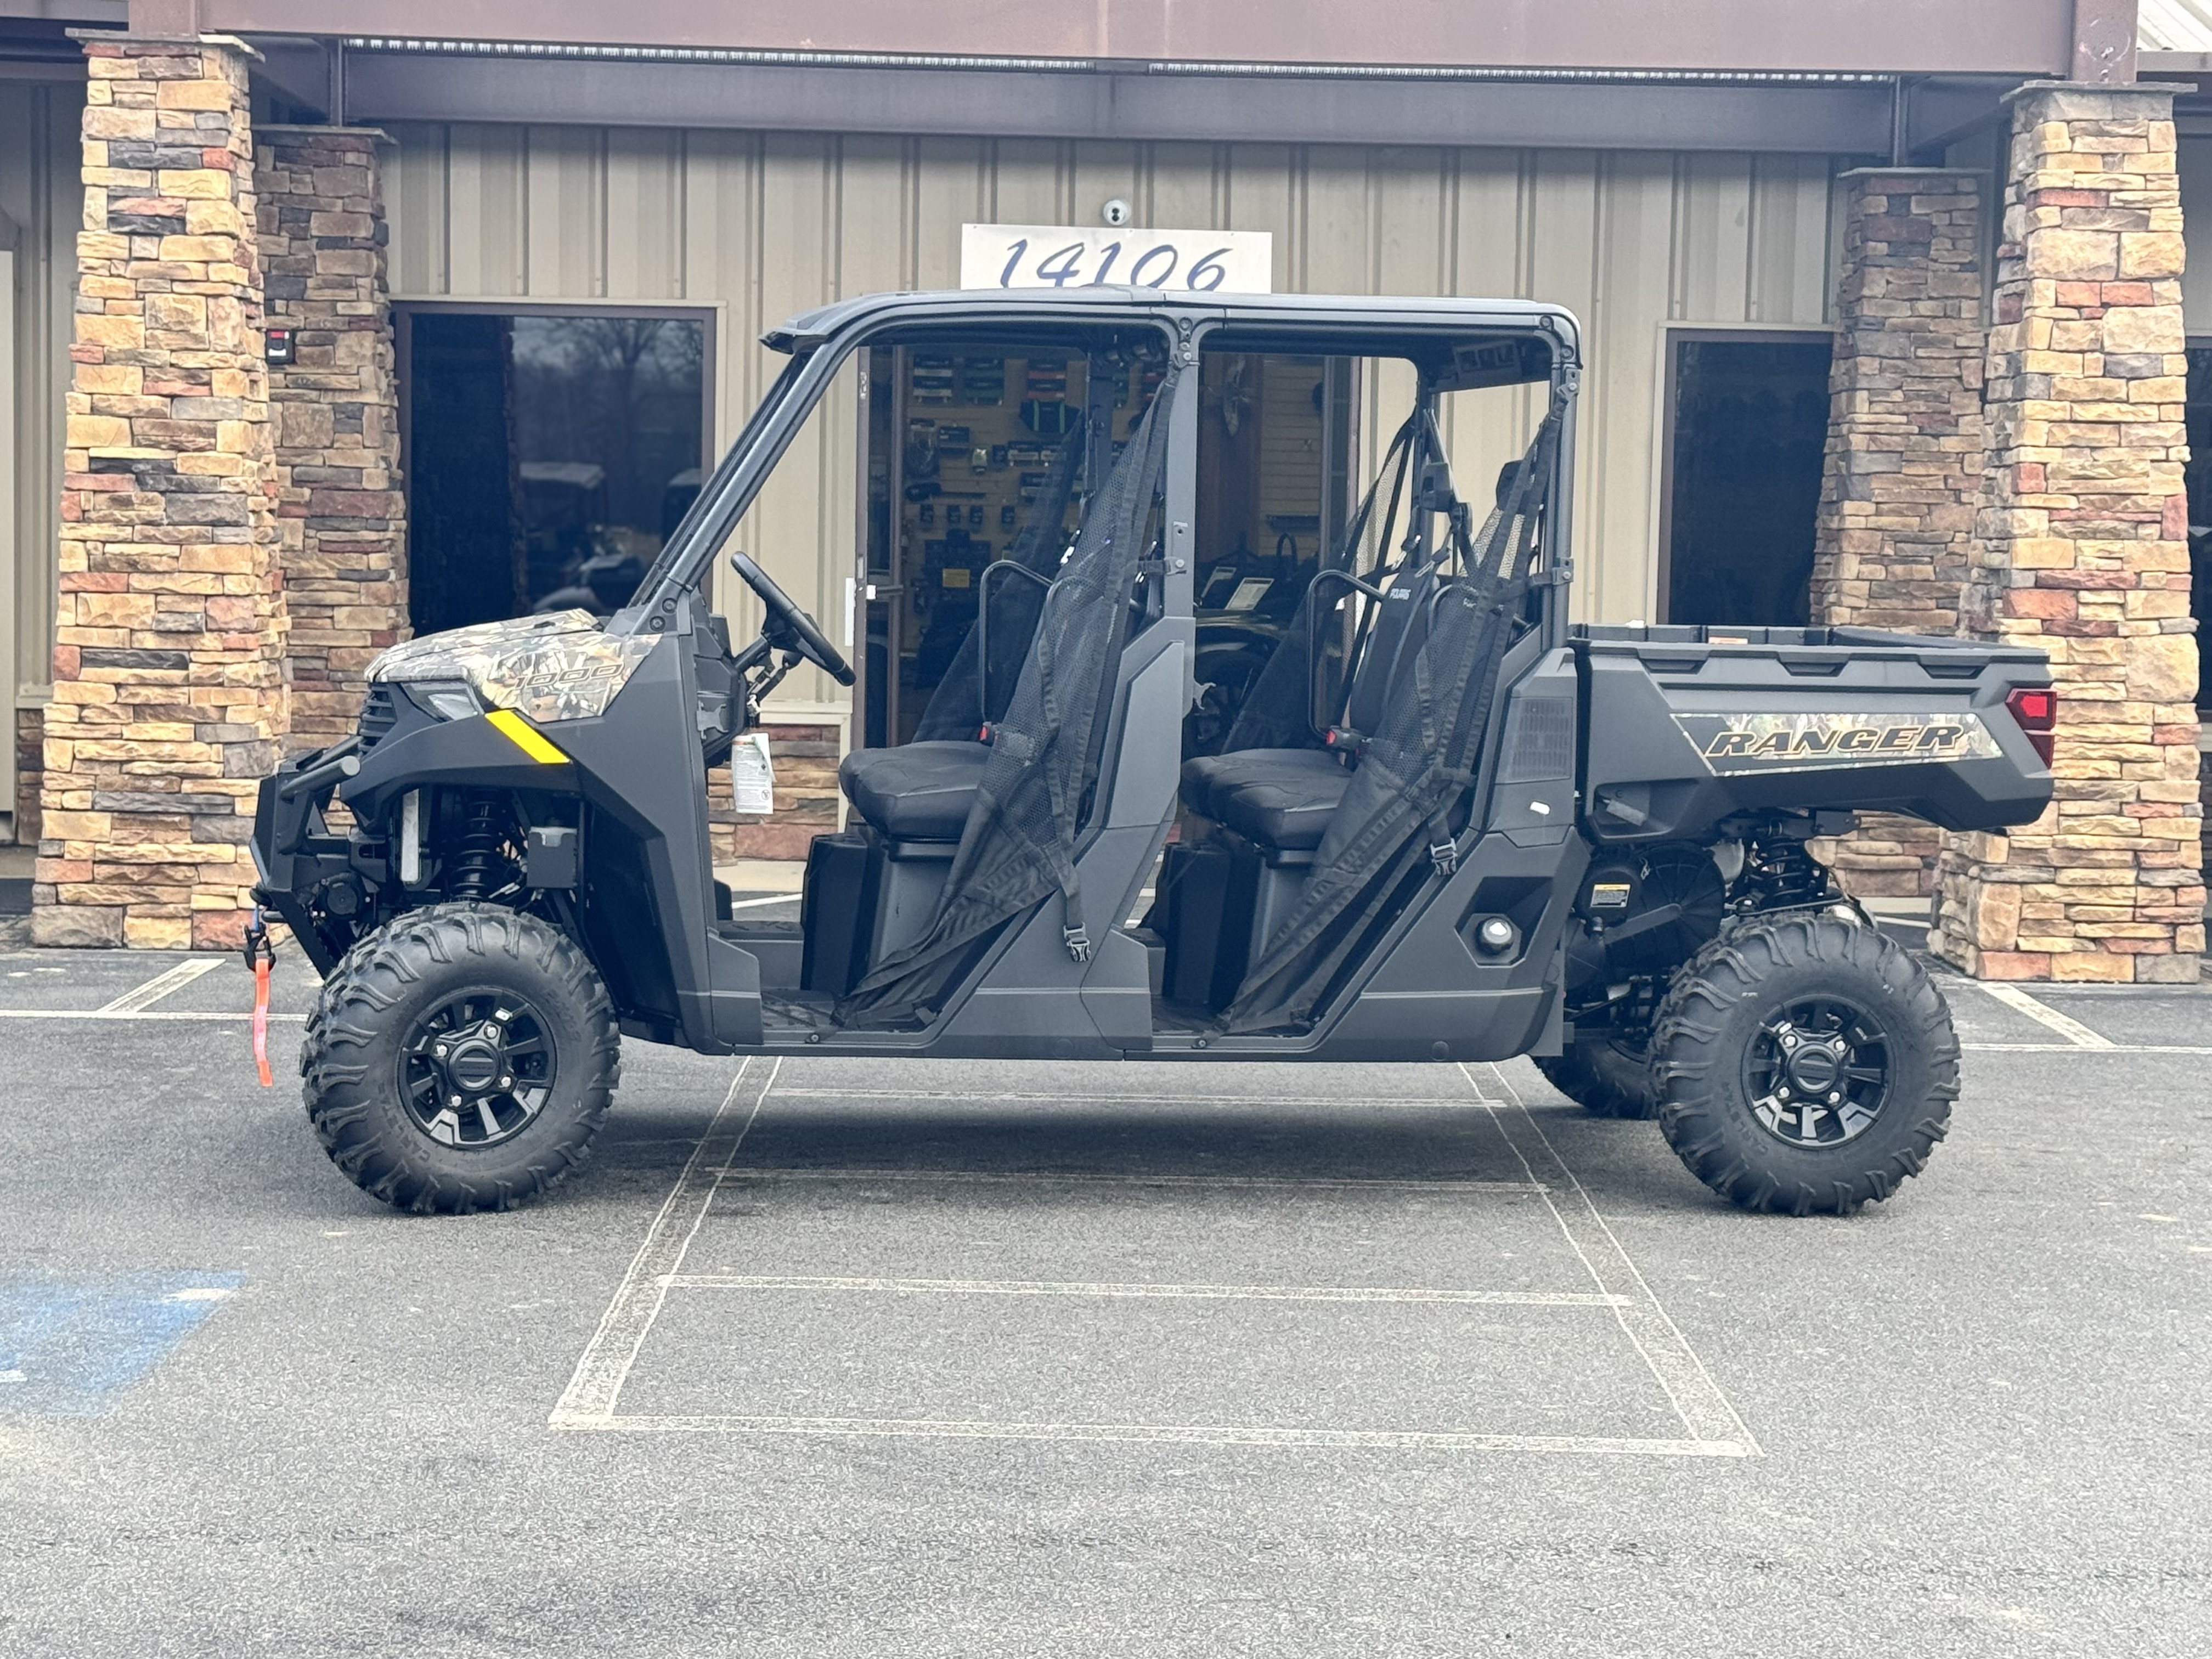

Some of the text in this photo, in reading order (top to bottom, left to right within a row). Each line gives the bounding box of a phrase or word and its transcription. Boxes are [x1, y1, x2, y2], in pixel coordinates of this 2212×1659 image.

[1000, 239, 1233, 291] 14106
[515, 662, 624, 690] 1000
[1705, 725, 1964, 757] RANGER
